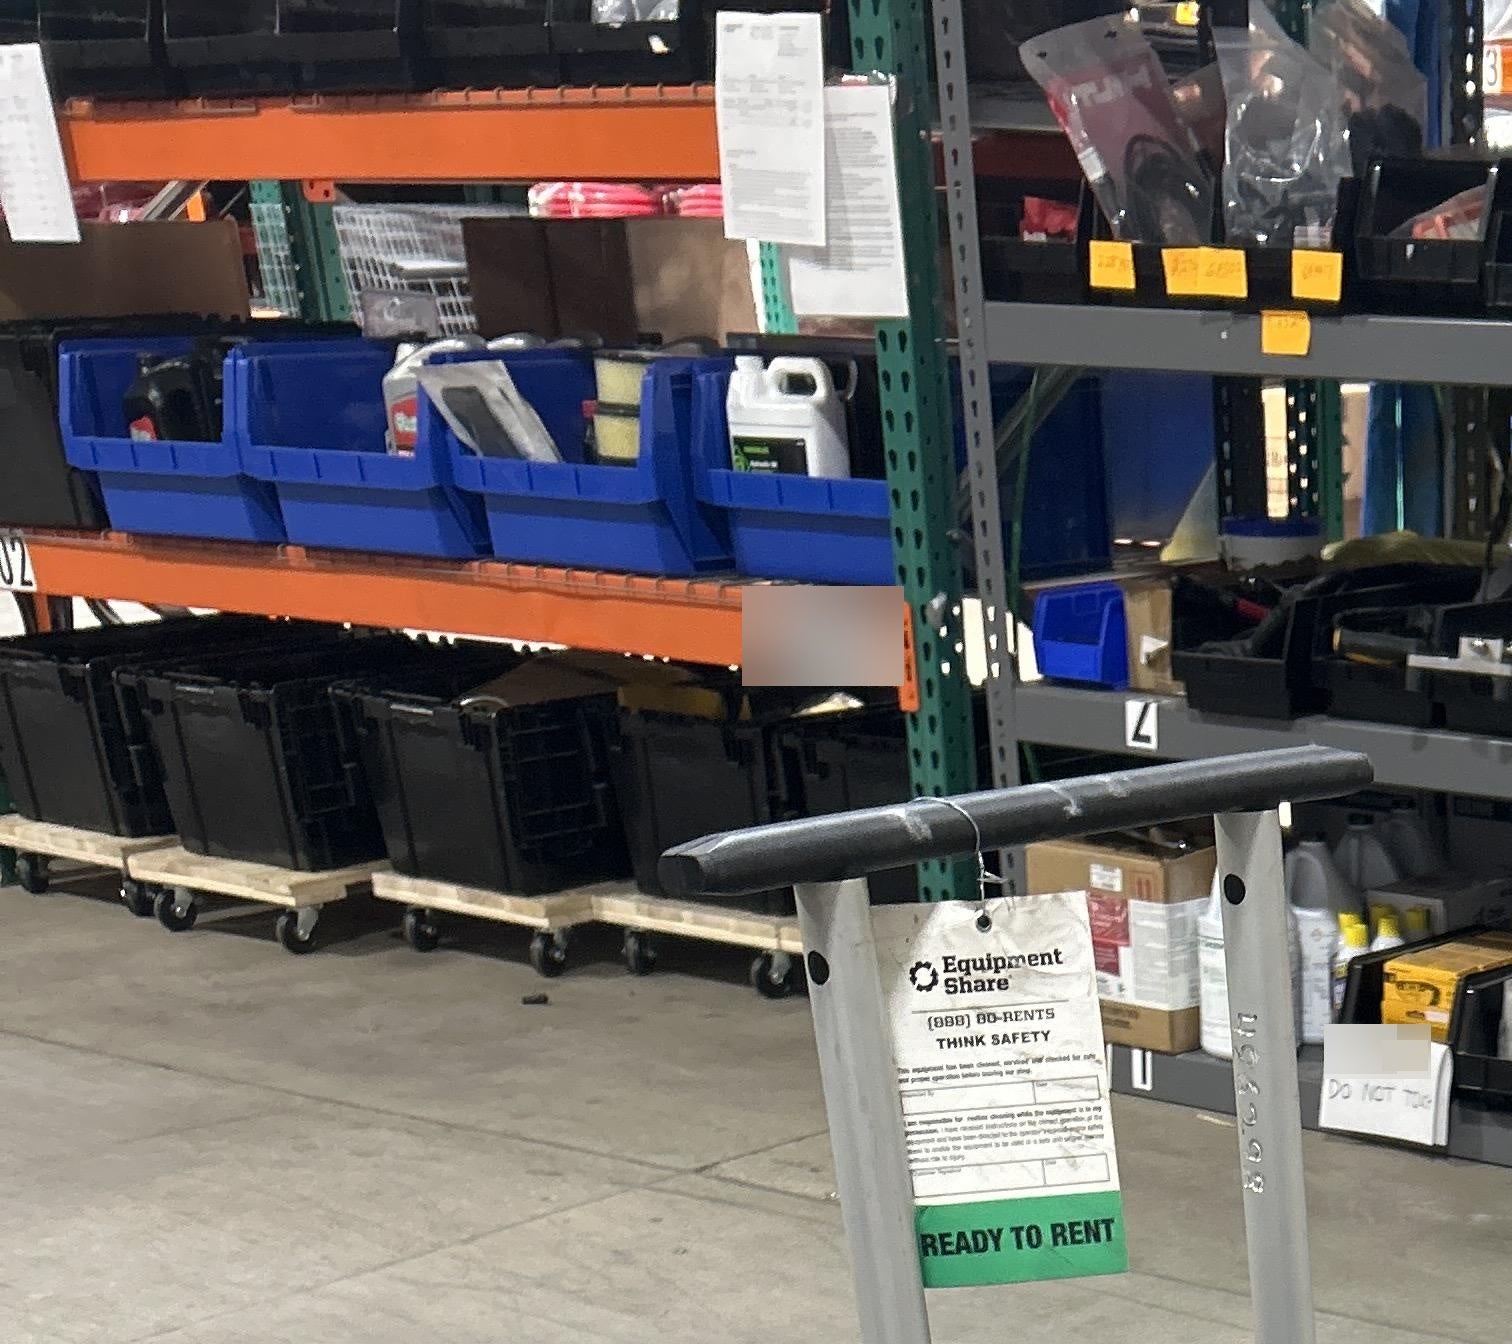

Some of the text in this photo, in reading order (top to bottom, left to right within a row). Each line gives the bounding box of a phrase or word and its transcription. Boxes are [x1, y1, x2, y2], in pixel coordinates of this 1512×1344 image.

[1485, 47, 1498, 87] 3
[942, 948, 1064, 976] Equipment
[944, 977, 1010, 995] Share
[936, 1030, 1051, 1050] THINK SAFETY
[919, 1217, 1115, 1257] READY TO RENT
